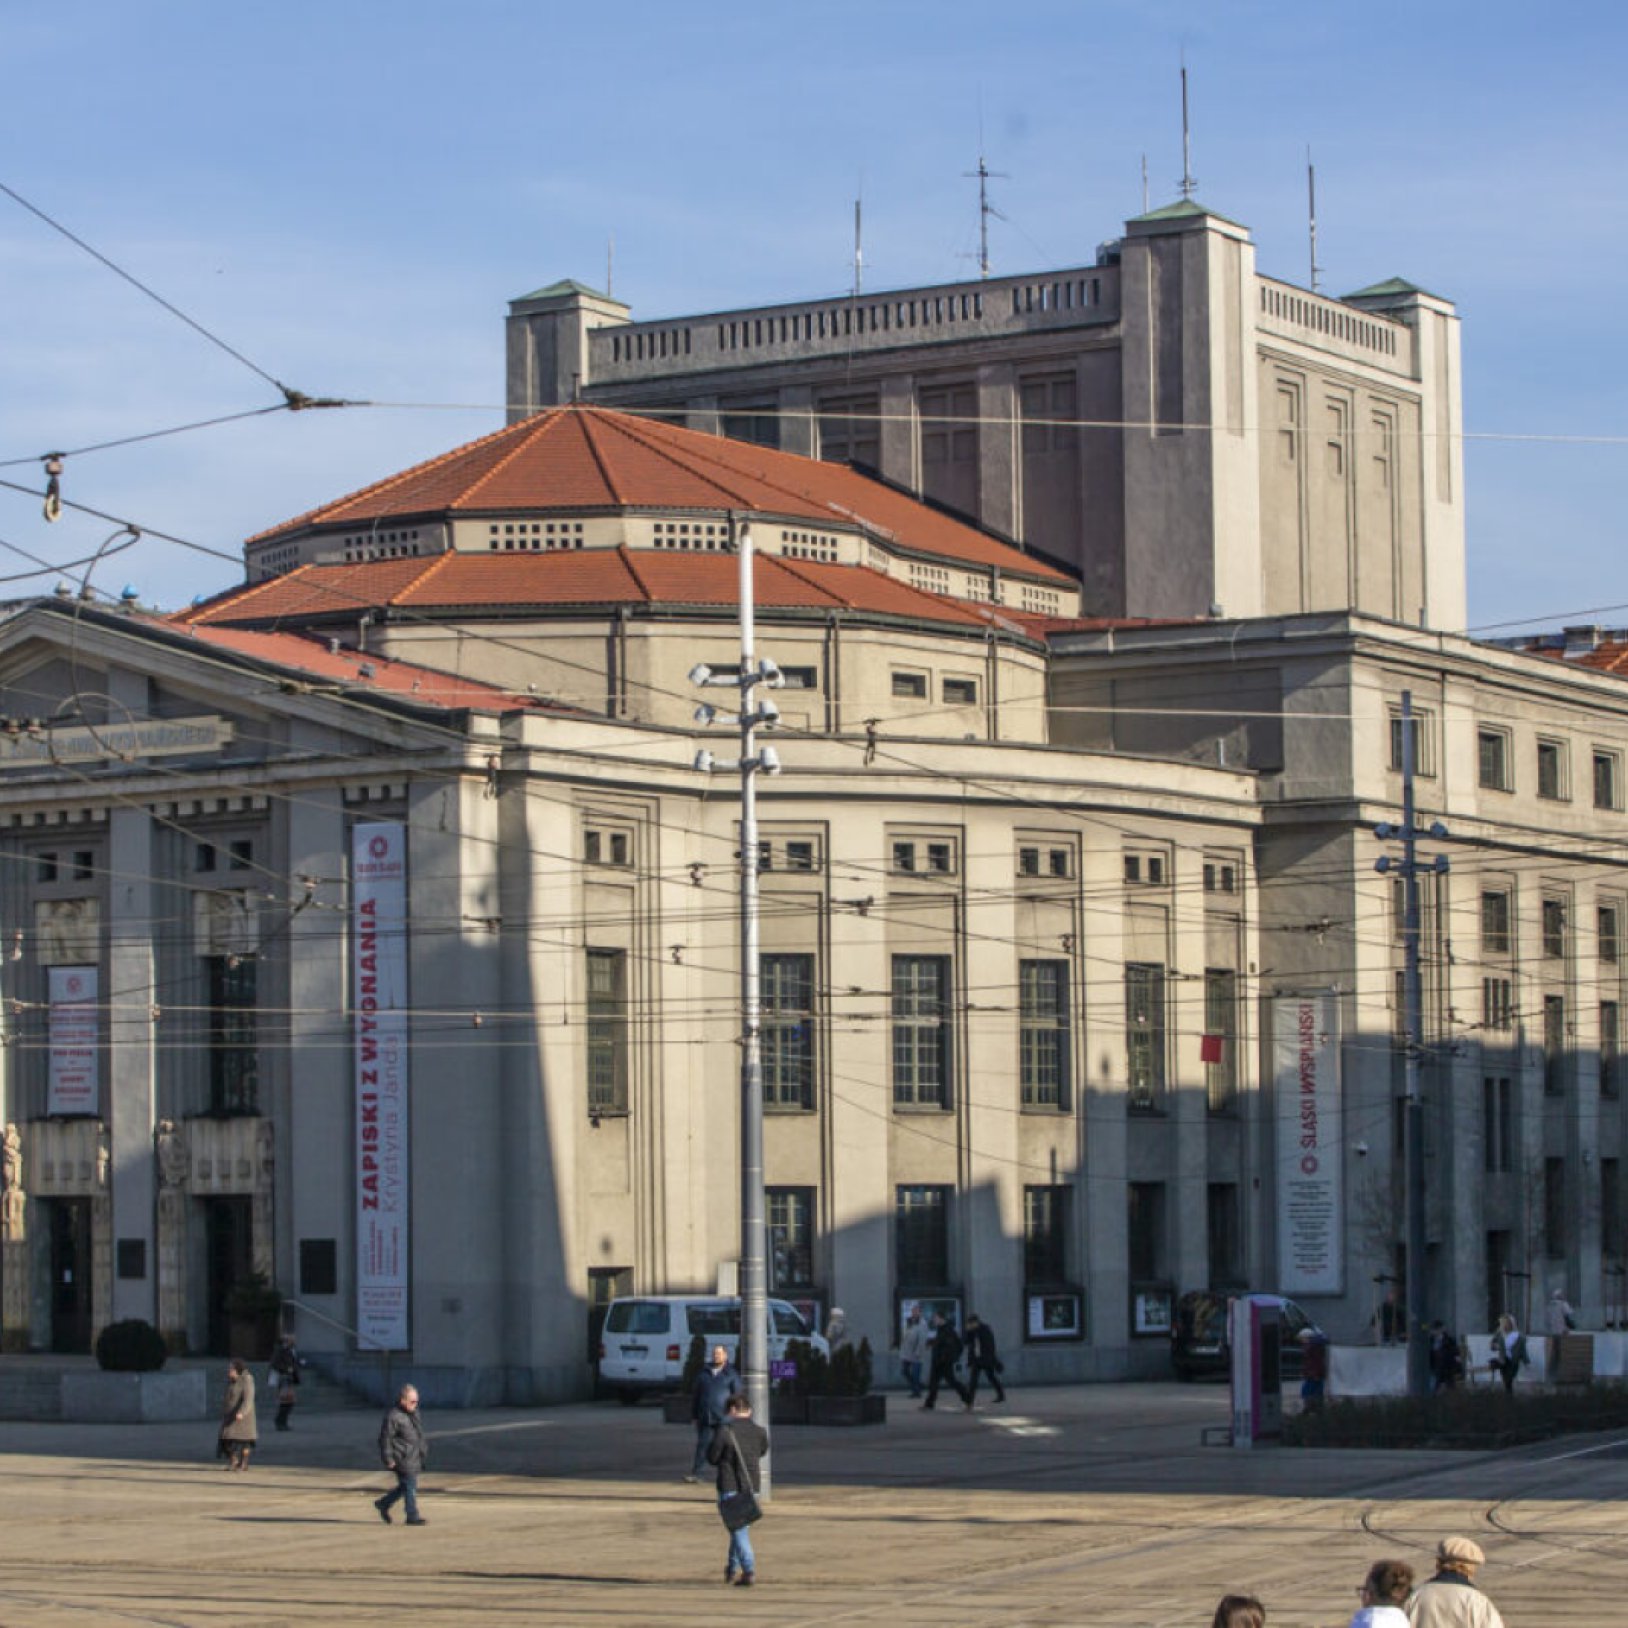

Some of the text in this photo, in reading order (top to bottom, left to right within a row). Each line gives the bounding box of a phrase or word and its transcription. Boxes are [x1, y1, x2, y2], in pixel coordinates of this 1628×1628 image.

[360, 899, 378, 1063] WYGNANIA
[361, 1069, 379, 1085] Z
[383, 1035, 398, 1106] Janda
[361, 1093, 380, 1210] ZAPISKI
[383, 1111, 400, 1213] Krystyna
